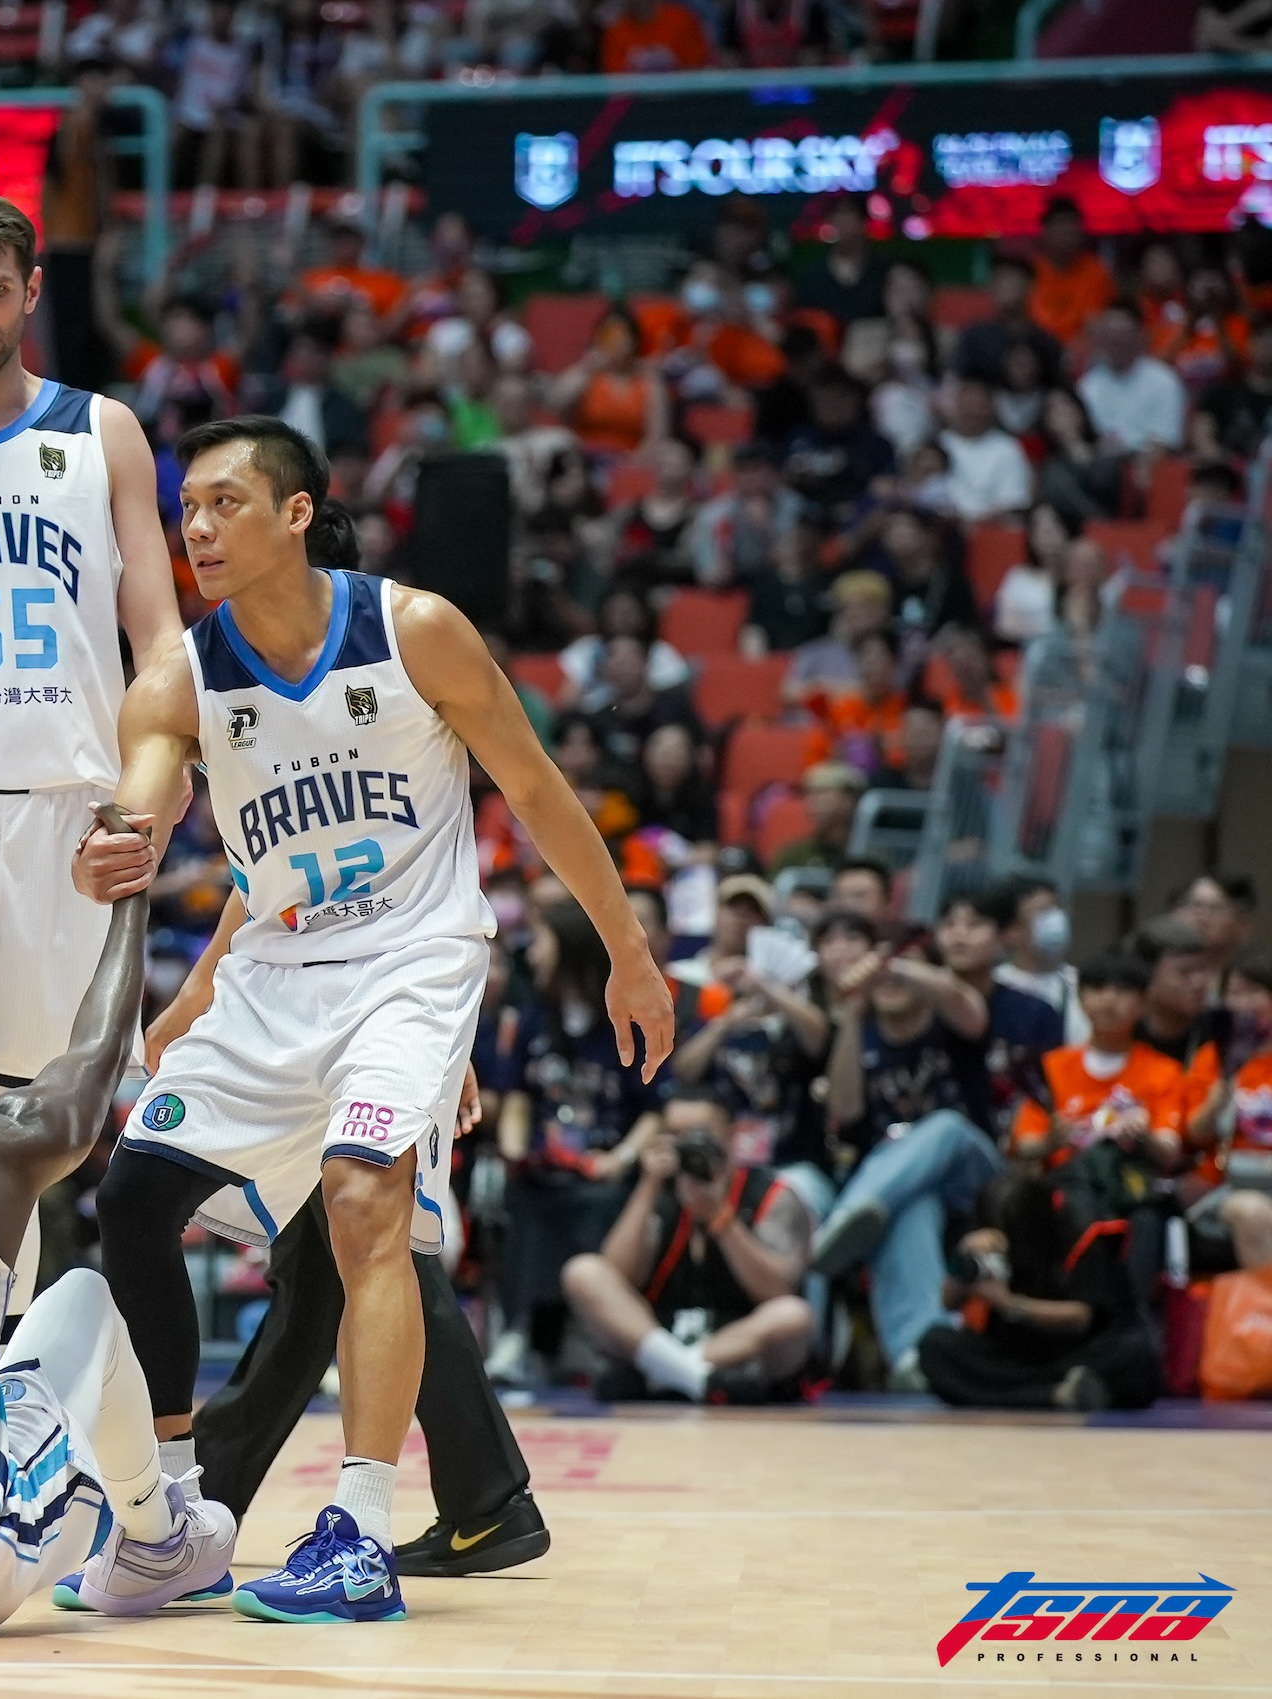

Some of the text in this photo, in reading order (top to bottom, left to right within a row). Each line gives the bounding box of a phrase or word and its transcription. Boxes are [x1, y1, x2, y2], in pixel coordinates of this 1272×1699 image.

[354, 712, 377, 726] TAIPEI
[230, 738, 256, 749] LEAGUE
[273, 748, 360, 774] FUBON
[239, 770, 421, 866] BRAVES
[288, 838, 385, 907] 12
